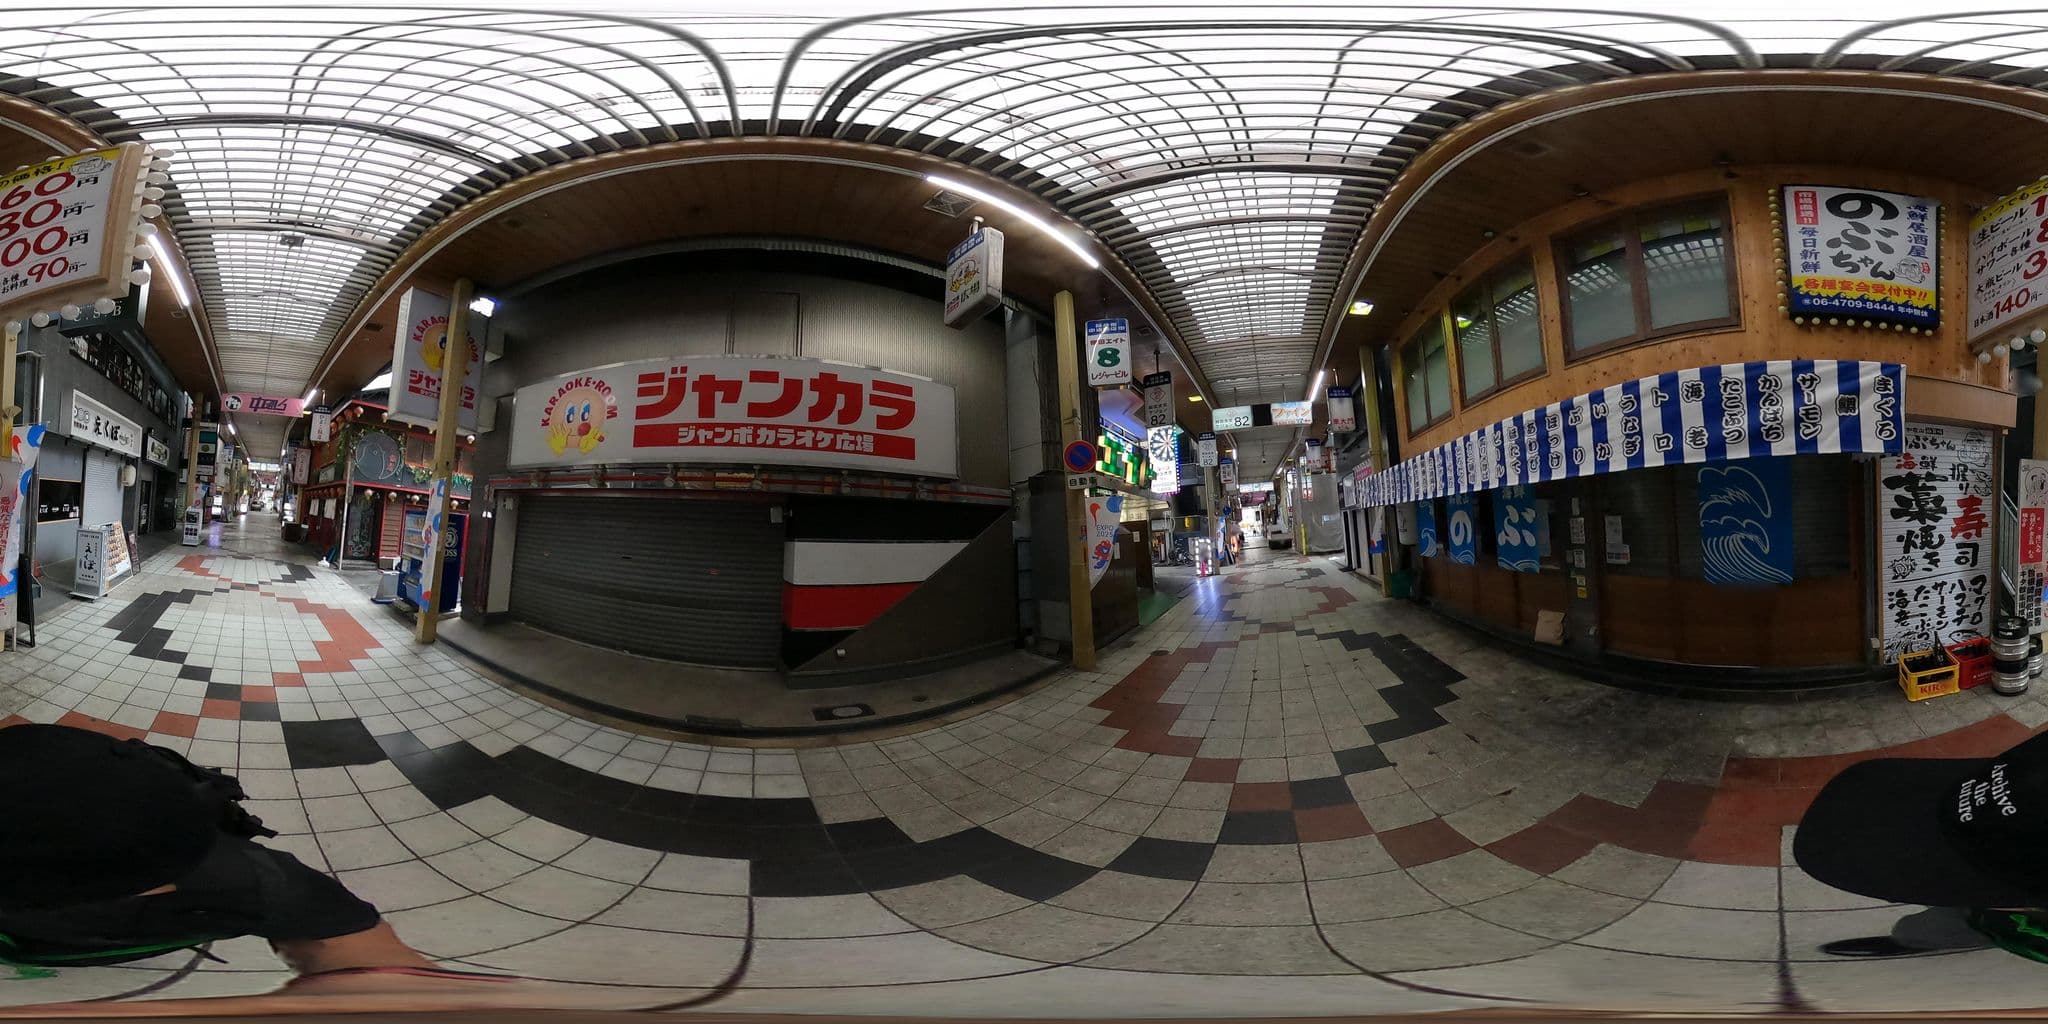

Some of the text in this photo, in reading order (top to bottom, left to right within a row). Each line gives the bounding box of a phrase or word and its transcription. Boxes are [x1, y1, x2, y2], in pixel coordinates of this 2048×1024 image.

[1825, 192, 1900, 281] のぶちゃん
[1907, 203, 1929, 260] 海鮮居酒屋
[1975, 228, 2034, 265] ハイボール
[1976, 207, 2029, 245] 生ビール
[1799, 226, 1821, 274] 毎日新鮮
[1, 278, 29, 294] お料理
[1804, 278, 1928, 301] 各種宴会受付中!!
[1812, 297, 1929, 317] 06-4709-8444 年中無休
[1973, 310, 1994, 329] 日本酒
[1091, 370, 1128, 380] レジャービル
[1097, 347, 1121, 367] 8
[634, 365, 917, 430] ジャンカラ
[1150, 413, 1166, 426] 82
[1650, 387, 1673, 452] トロ
[1681, 380, 1709, 450] 海老
[1720, 377, 1746, 444] たこぶつ
[1797, 373, 1822, 440] サーモン
[1874, 375, 1896, 441] まぐろ
[94, 415, 121, 441] えくぼ
[676, 425, 875, 453] ジャンボカラオケ広場
[1234, 416, 1250, 427] 82
[1546, 413, 1563, 469] ほっけ
[1568, 399, 1586, 466] ぶり
[1592, 402, 1613, 461] いか
[1619, 394, 1641, 458] うなぎ
[1905, 434, 1956, 451] ぶちゃん
[1526, 421, 1540, 472] あわび
[1895, 452, 1938, 471] 海鮮
[1096, 530, 1114, 538] 2025
[1450, 510, 1472, 546] の
[1497, 504, 1536, 547] ぶ
[1883, 471, 1948, 573] 藁焼き
[1888, 590, 1911, 628] 海老
[1932, 581, 1949, 630] サーモン
[1949, 578, 1971, 627] ハマチ
[1968, 574, 1988, 626] マグロ
[1958, 779, 1977, 823] future
[1974, 781, 1991, 807] the
[1991, 763, 2017, 816] Archive
